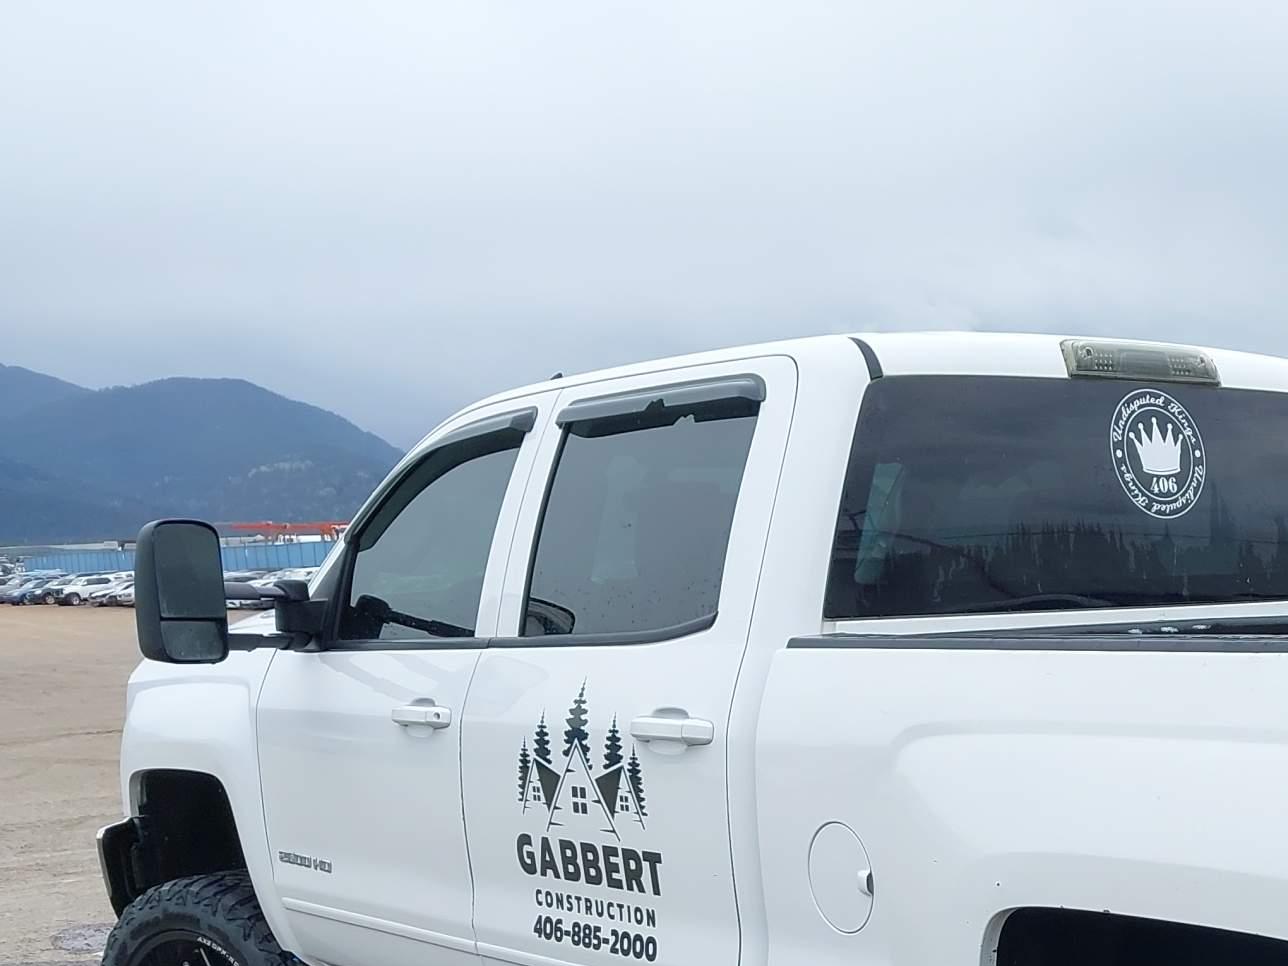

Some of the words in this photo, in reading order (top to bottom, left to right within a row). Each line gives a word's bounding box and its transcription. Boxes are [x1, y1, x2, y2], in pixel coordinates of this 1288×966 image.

[1112, 393, 1166, 442] Undisputed
[1167, 402, 1197, 445] Kings
[1150, 476, 1178, 494] 406
[516, 832, 663, 897] GABBERT
[535, 888, 657, 929] CONSTRUCTION
[533, 914, 658, 963] 406-885-2000
